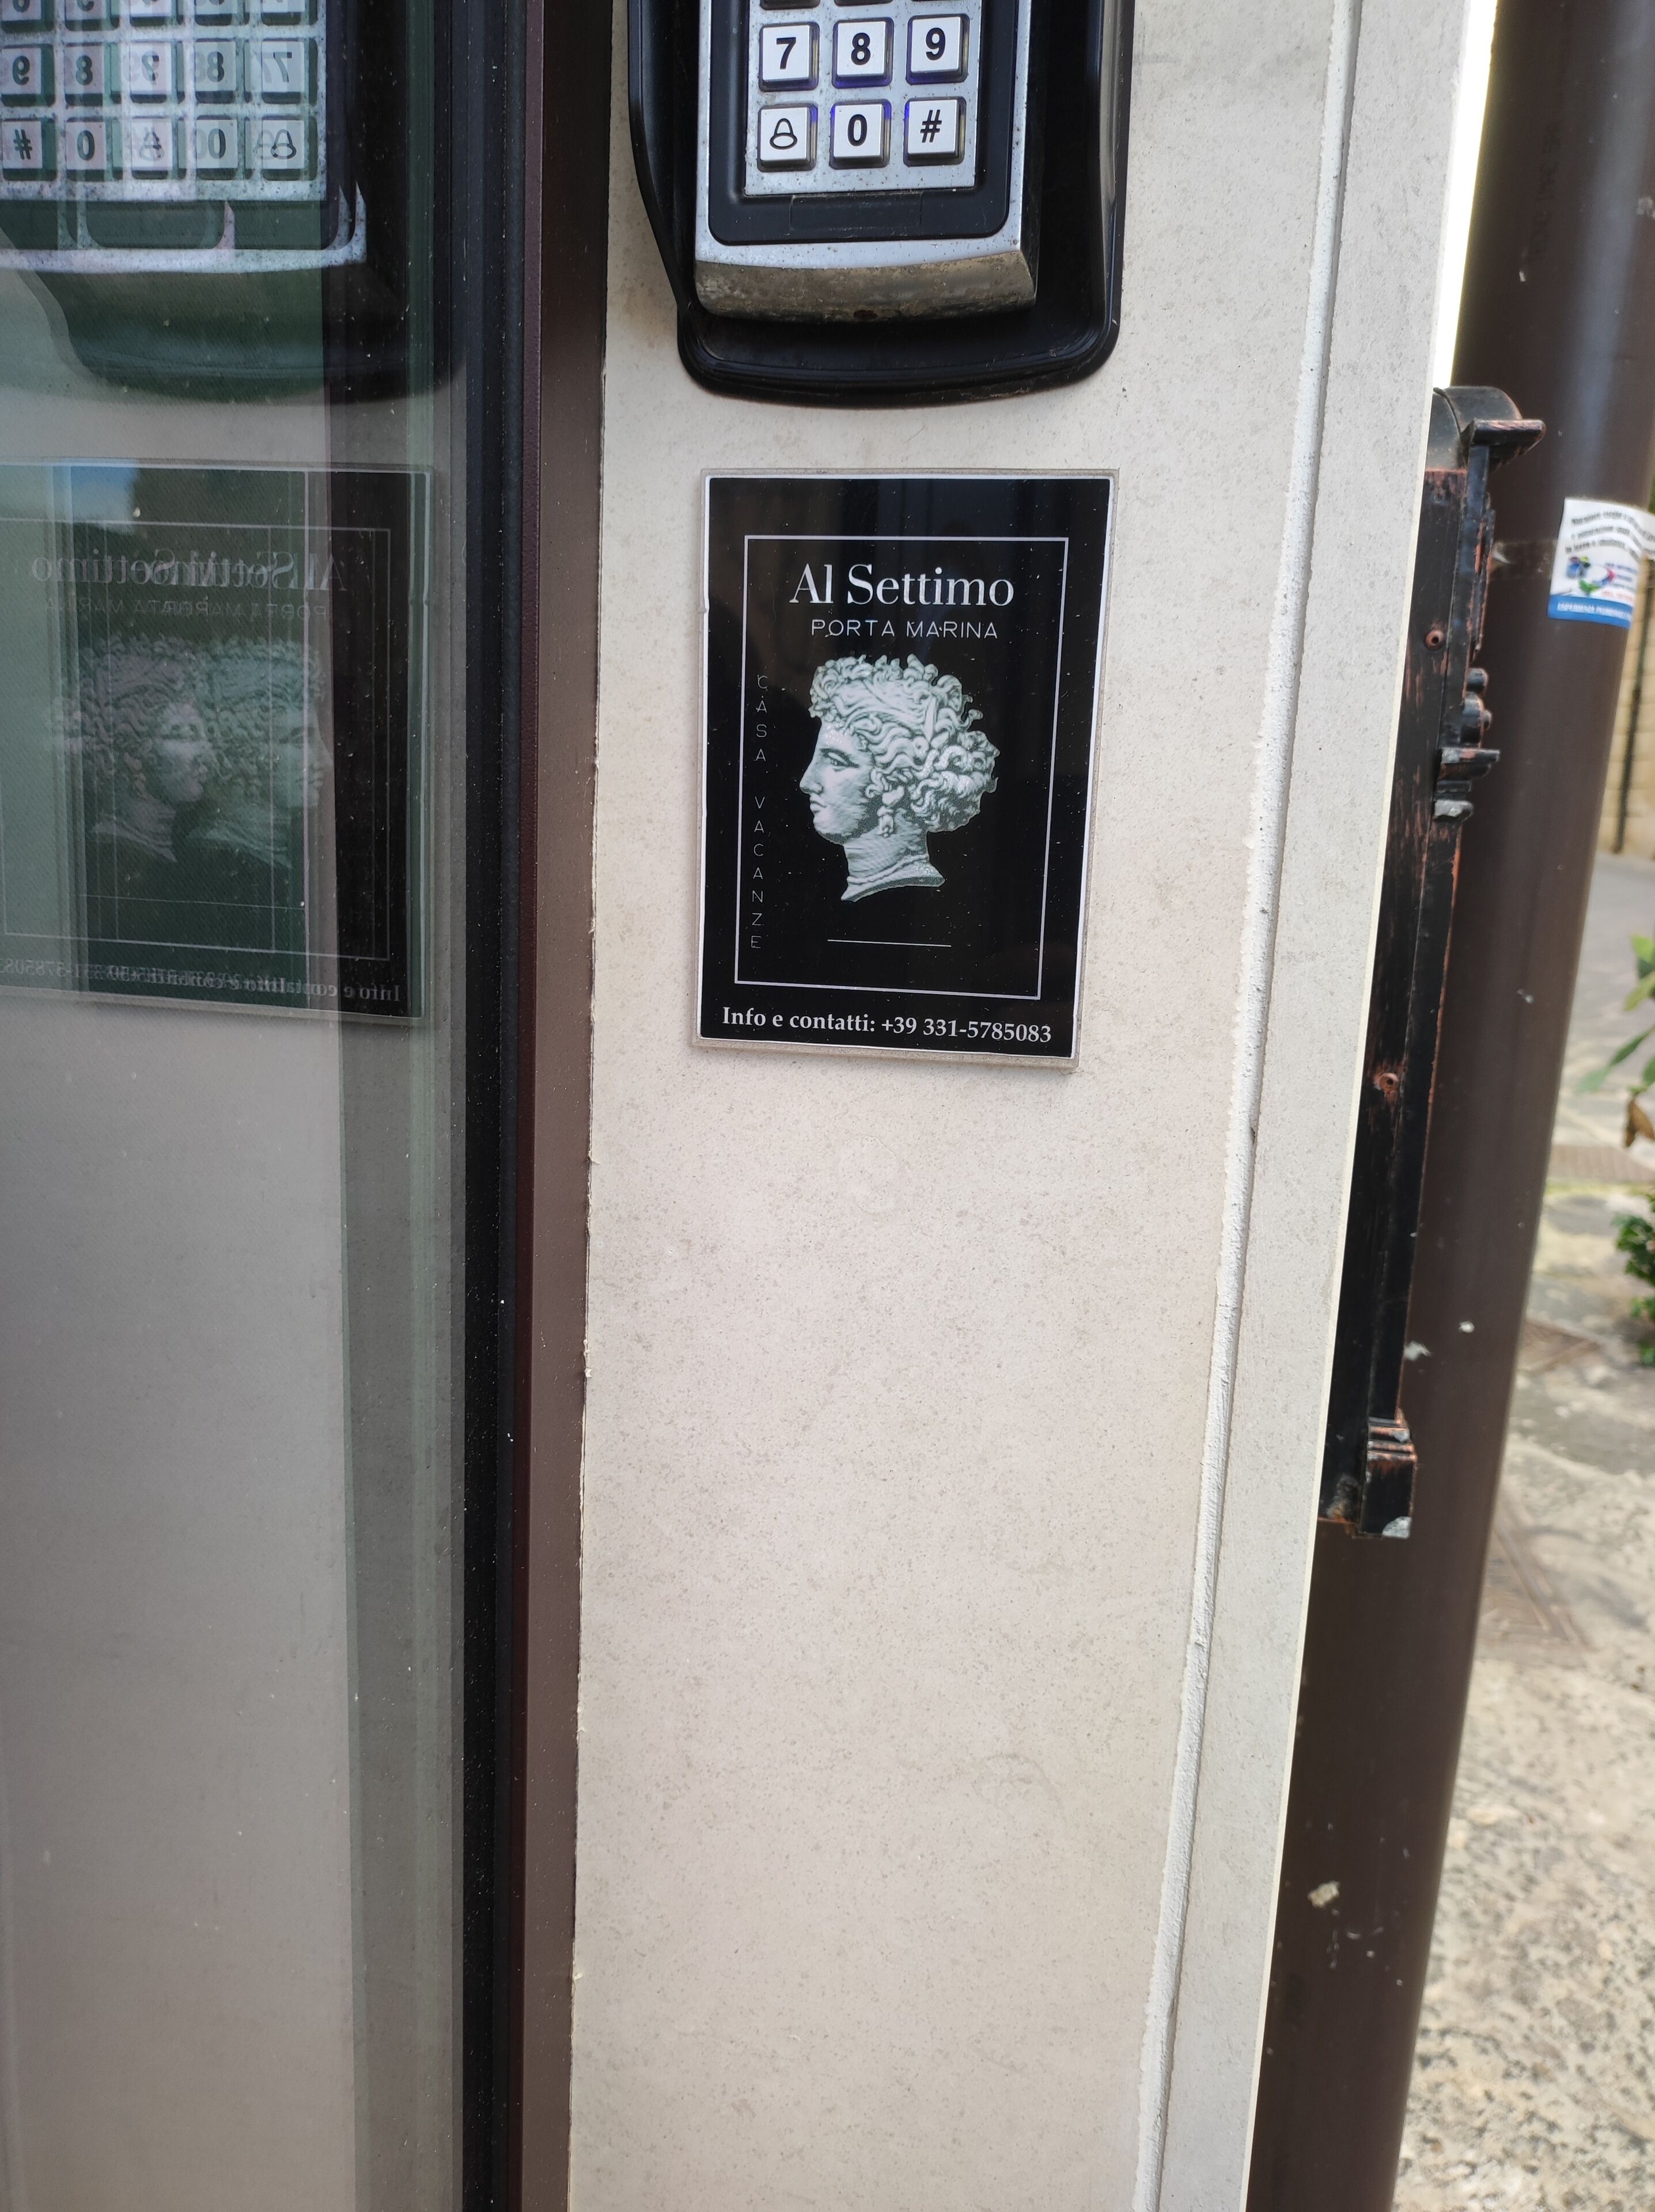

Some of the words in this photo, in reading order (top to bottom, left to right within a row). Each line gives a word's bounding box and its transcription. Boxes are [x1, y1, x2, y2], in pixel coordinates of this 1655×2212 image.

[776, 37, 796, 70] 7
[851, 32, 871, 66] 8
[925, 27, 946, 60] 9
[847, 113, 868, 146] 0
[920, 109, 942, 143] #
[789, 563, 834, 604] Al
[847, 564, 1014, 606] Settimo
[812, 619, 895, 637] PORTA
[907, 620, 998, 639] MARINA
[755, 675, 768, 762] CASA
[751, 796, 765, 949] VACANZE
[722, 1007, 766, 1026] Info
[772, 1014, 783, 1027] e
[790, 1013, 875, 1032] contatti:
[881, 1017, 917, 1035] +39
[923, 1018, 1052, 1043] 331-5785083
